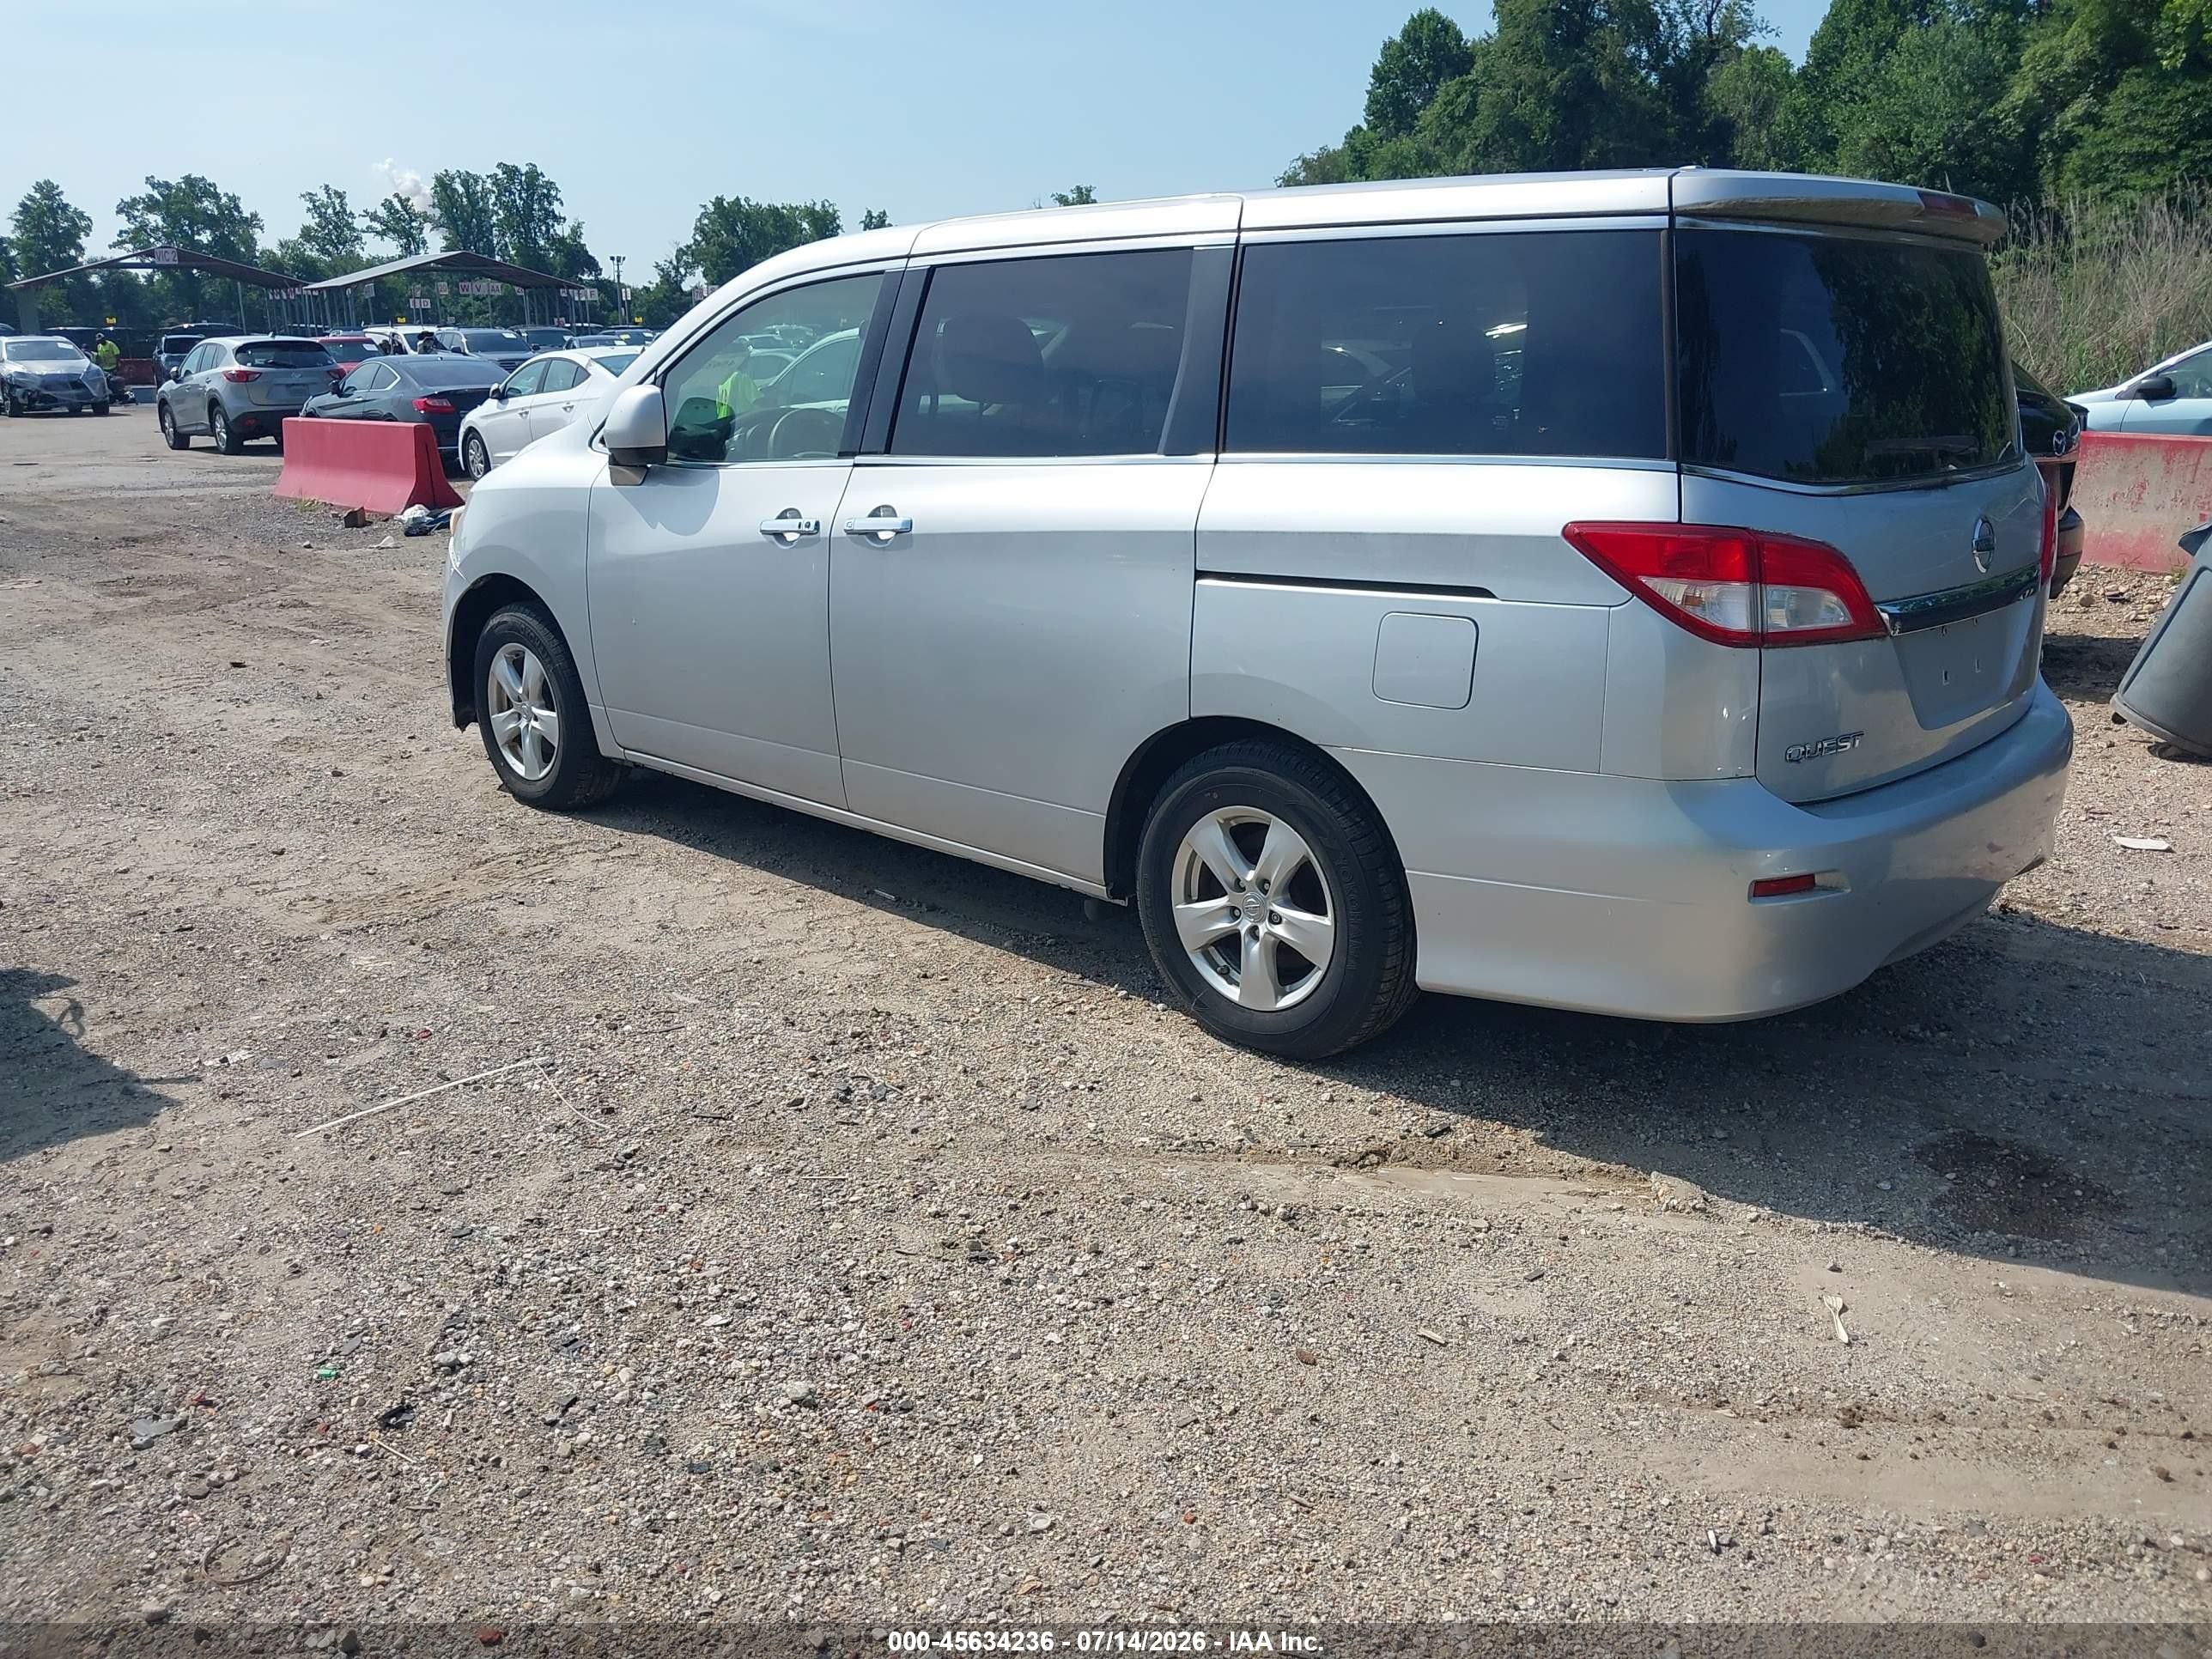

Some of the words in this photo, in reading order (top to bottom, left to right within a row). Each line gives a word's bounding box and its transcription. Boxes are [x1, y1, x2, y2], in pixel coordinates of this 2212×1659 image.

[155, 250, 170, 262] VIC
[172, 250, 178, 262] 2
[460, 284, 470, 293] W
[1785, 731, 1865, 763] QUEST
